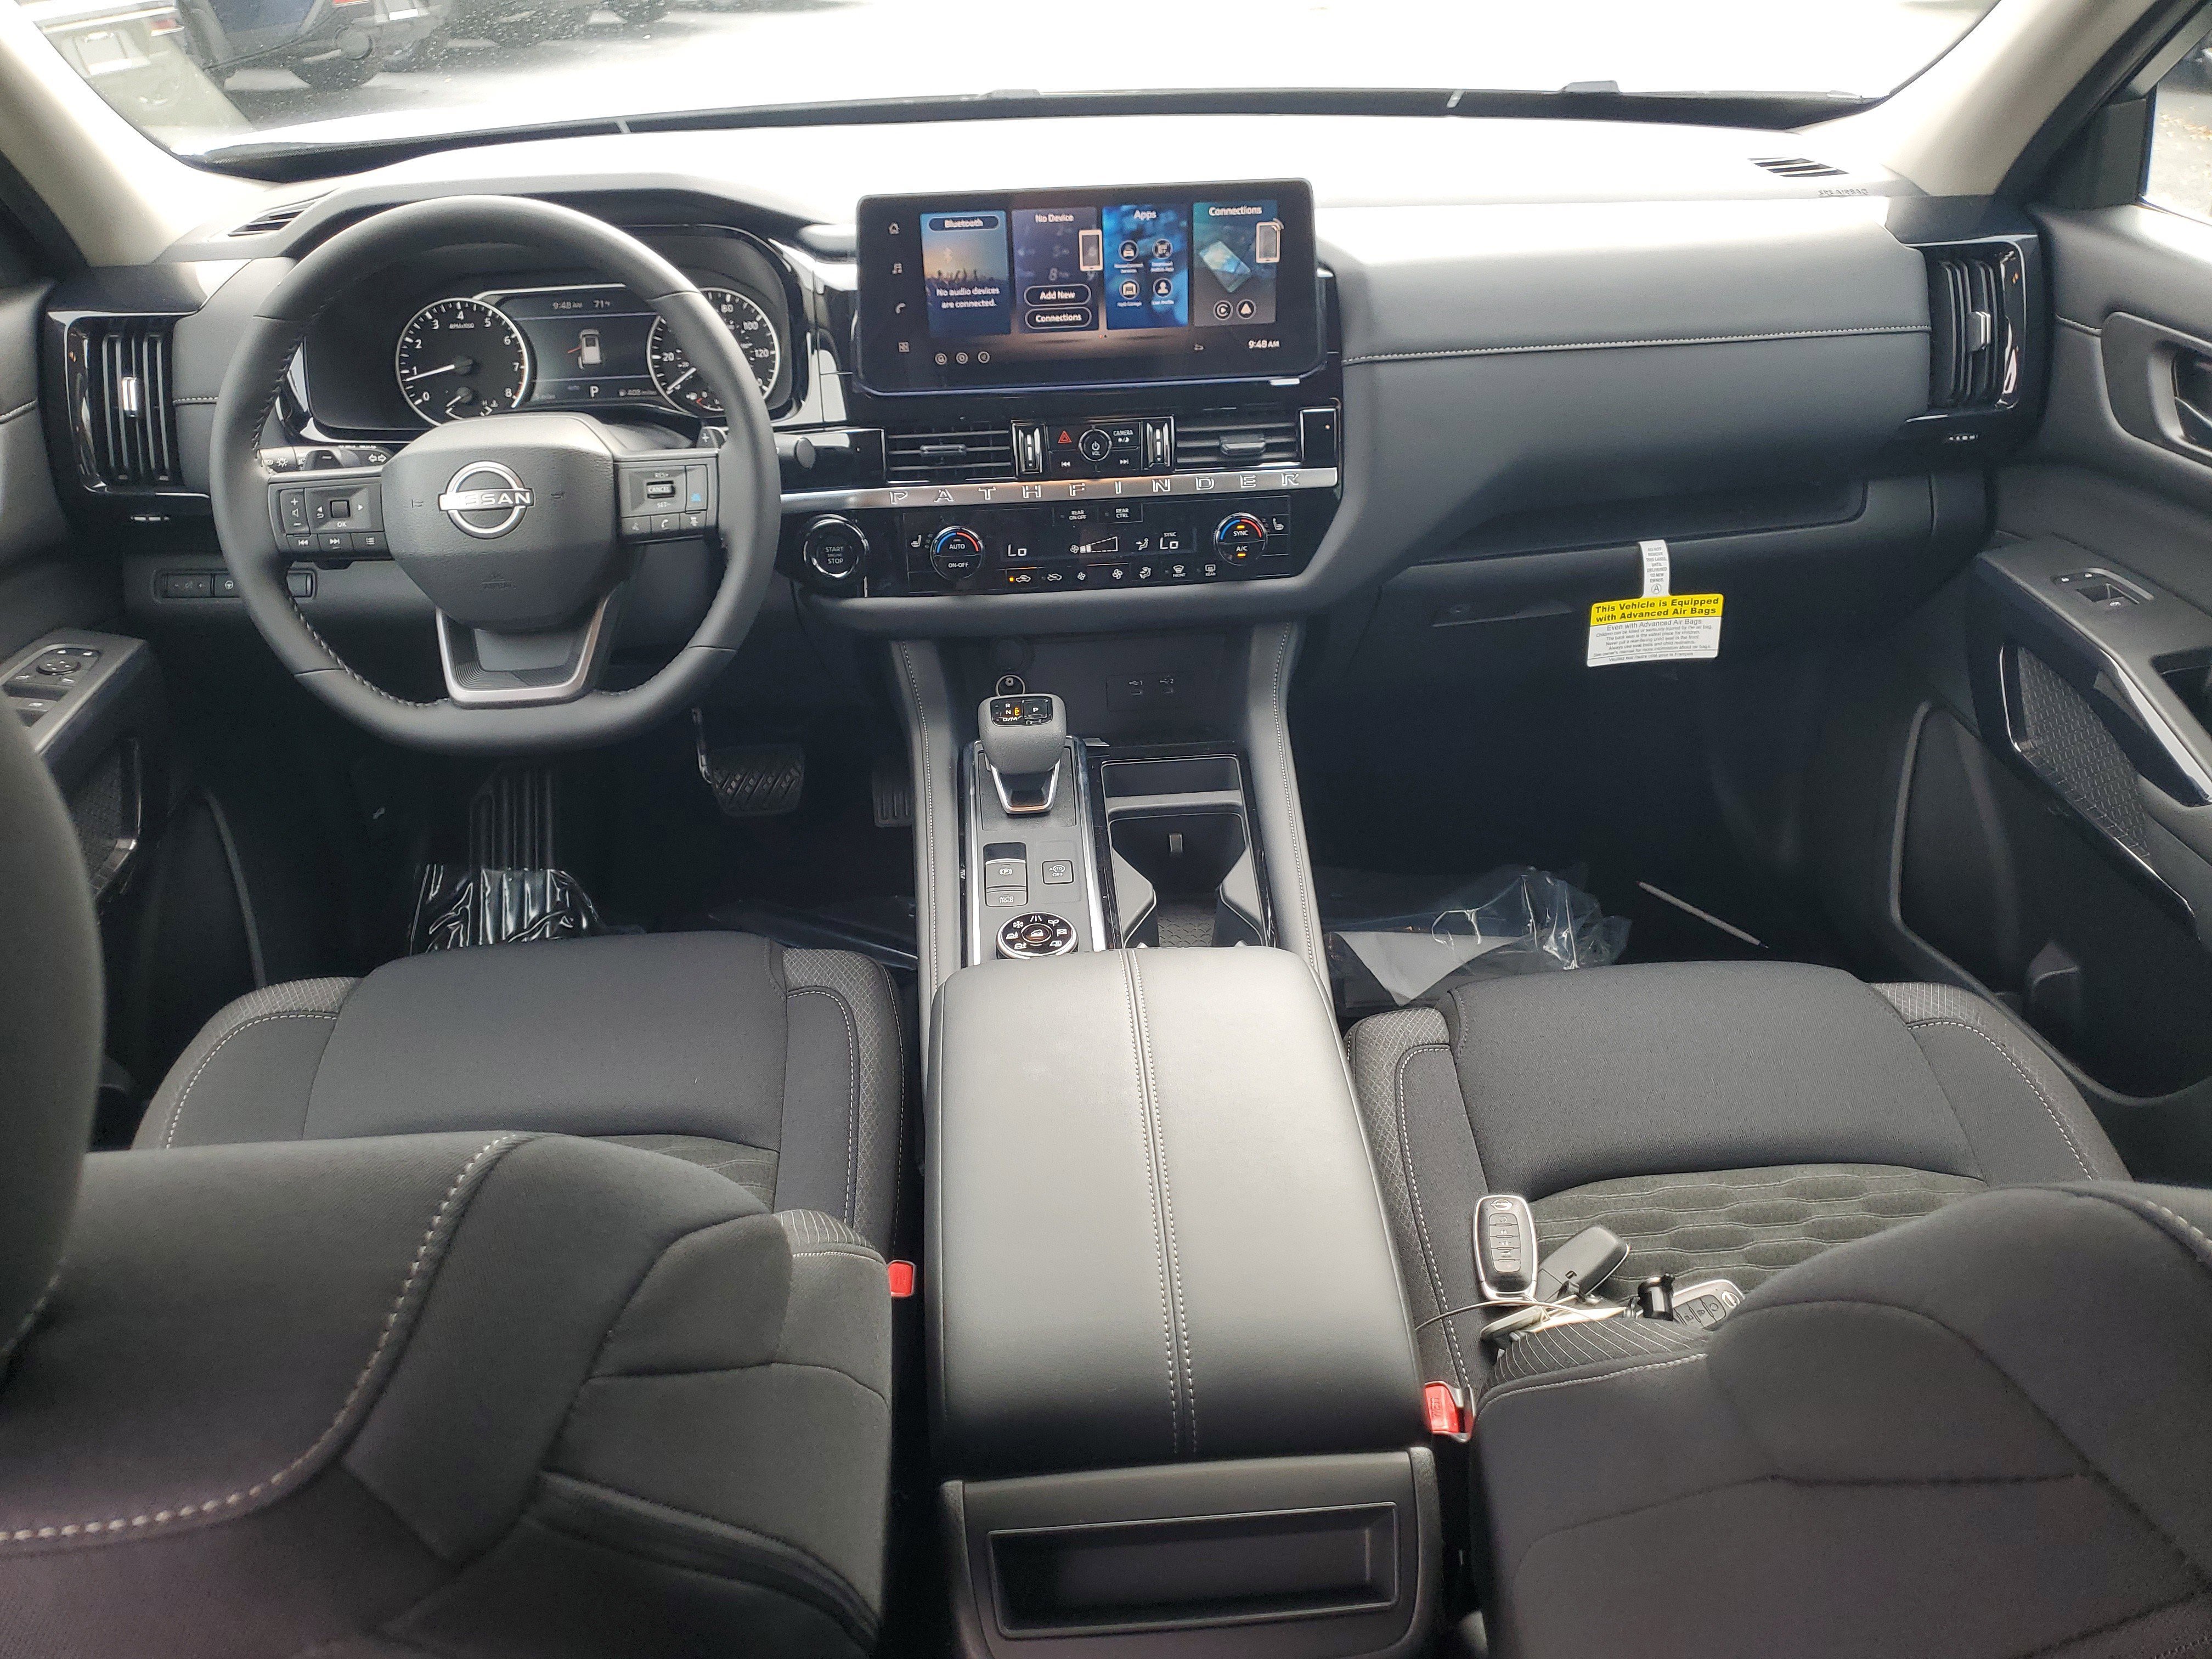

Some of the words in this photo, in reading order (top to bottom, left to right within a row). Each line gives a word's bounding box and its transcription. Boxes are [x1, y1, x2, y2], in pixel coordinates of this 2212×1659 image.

[1133, 210, 1158, 220] Apps
[1209, 205, 1262, 217] Connections
[944, 217, 984, 228] Bluetooth
[1035, 214, 1047, 223] No
[1048, 213, 1074, 222] Device
[936, 289, 948, 297] No
[949, 287, 972, 296] audio
[972, 286, 1000, 295] devices
[1040, 291, 1056, 300] Add
[1057, 291, 1075, 300] New
[955, 298, 997, 308] connected.
[456, 311, 464, 320] 4
[1035, 313, 1082, 323] Connections
[432, 319, 439, 329] 3
[484, 318, 492, 328] 5
[743, 321, 759, 330] 100
[415, 339, 422, 349] 2
[504, 336, 511, 345] 6
[1248, 339, 1267, 349] 9:48
[662, 352, 675, 362] 20
[754, 348, 769, 358] 120
[412, 366, 417, 375] 1
[512, 362, 520, 371] 7
[422, 391, 430, 401] 0
[504, 388, 512, 398] 8
[590, 385, 599, 397] P
[889, 472, 1299, 505] PATHFINDER
[443, 492, 531, 509] SSAN
[1159, 537, 1179, 549] Lo
[1007, 544, 1027, 557] Lo
[1653, 584, 1660, 592] A
[1595, 605, 1616, 613] This
[1619, 601, 1655, 610] Vehicle
[1671, 597, 1719, 607] Equipped
[1596, 614, 1616, 622] with
[1620, 609, 1668, 619] Advanced
